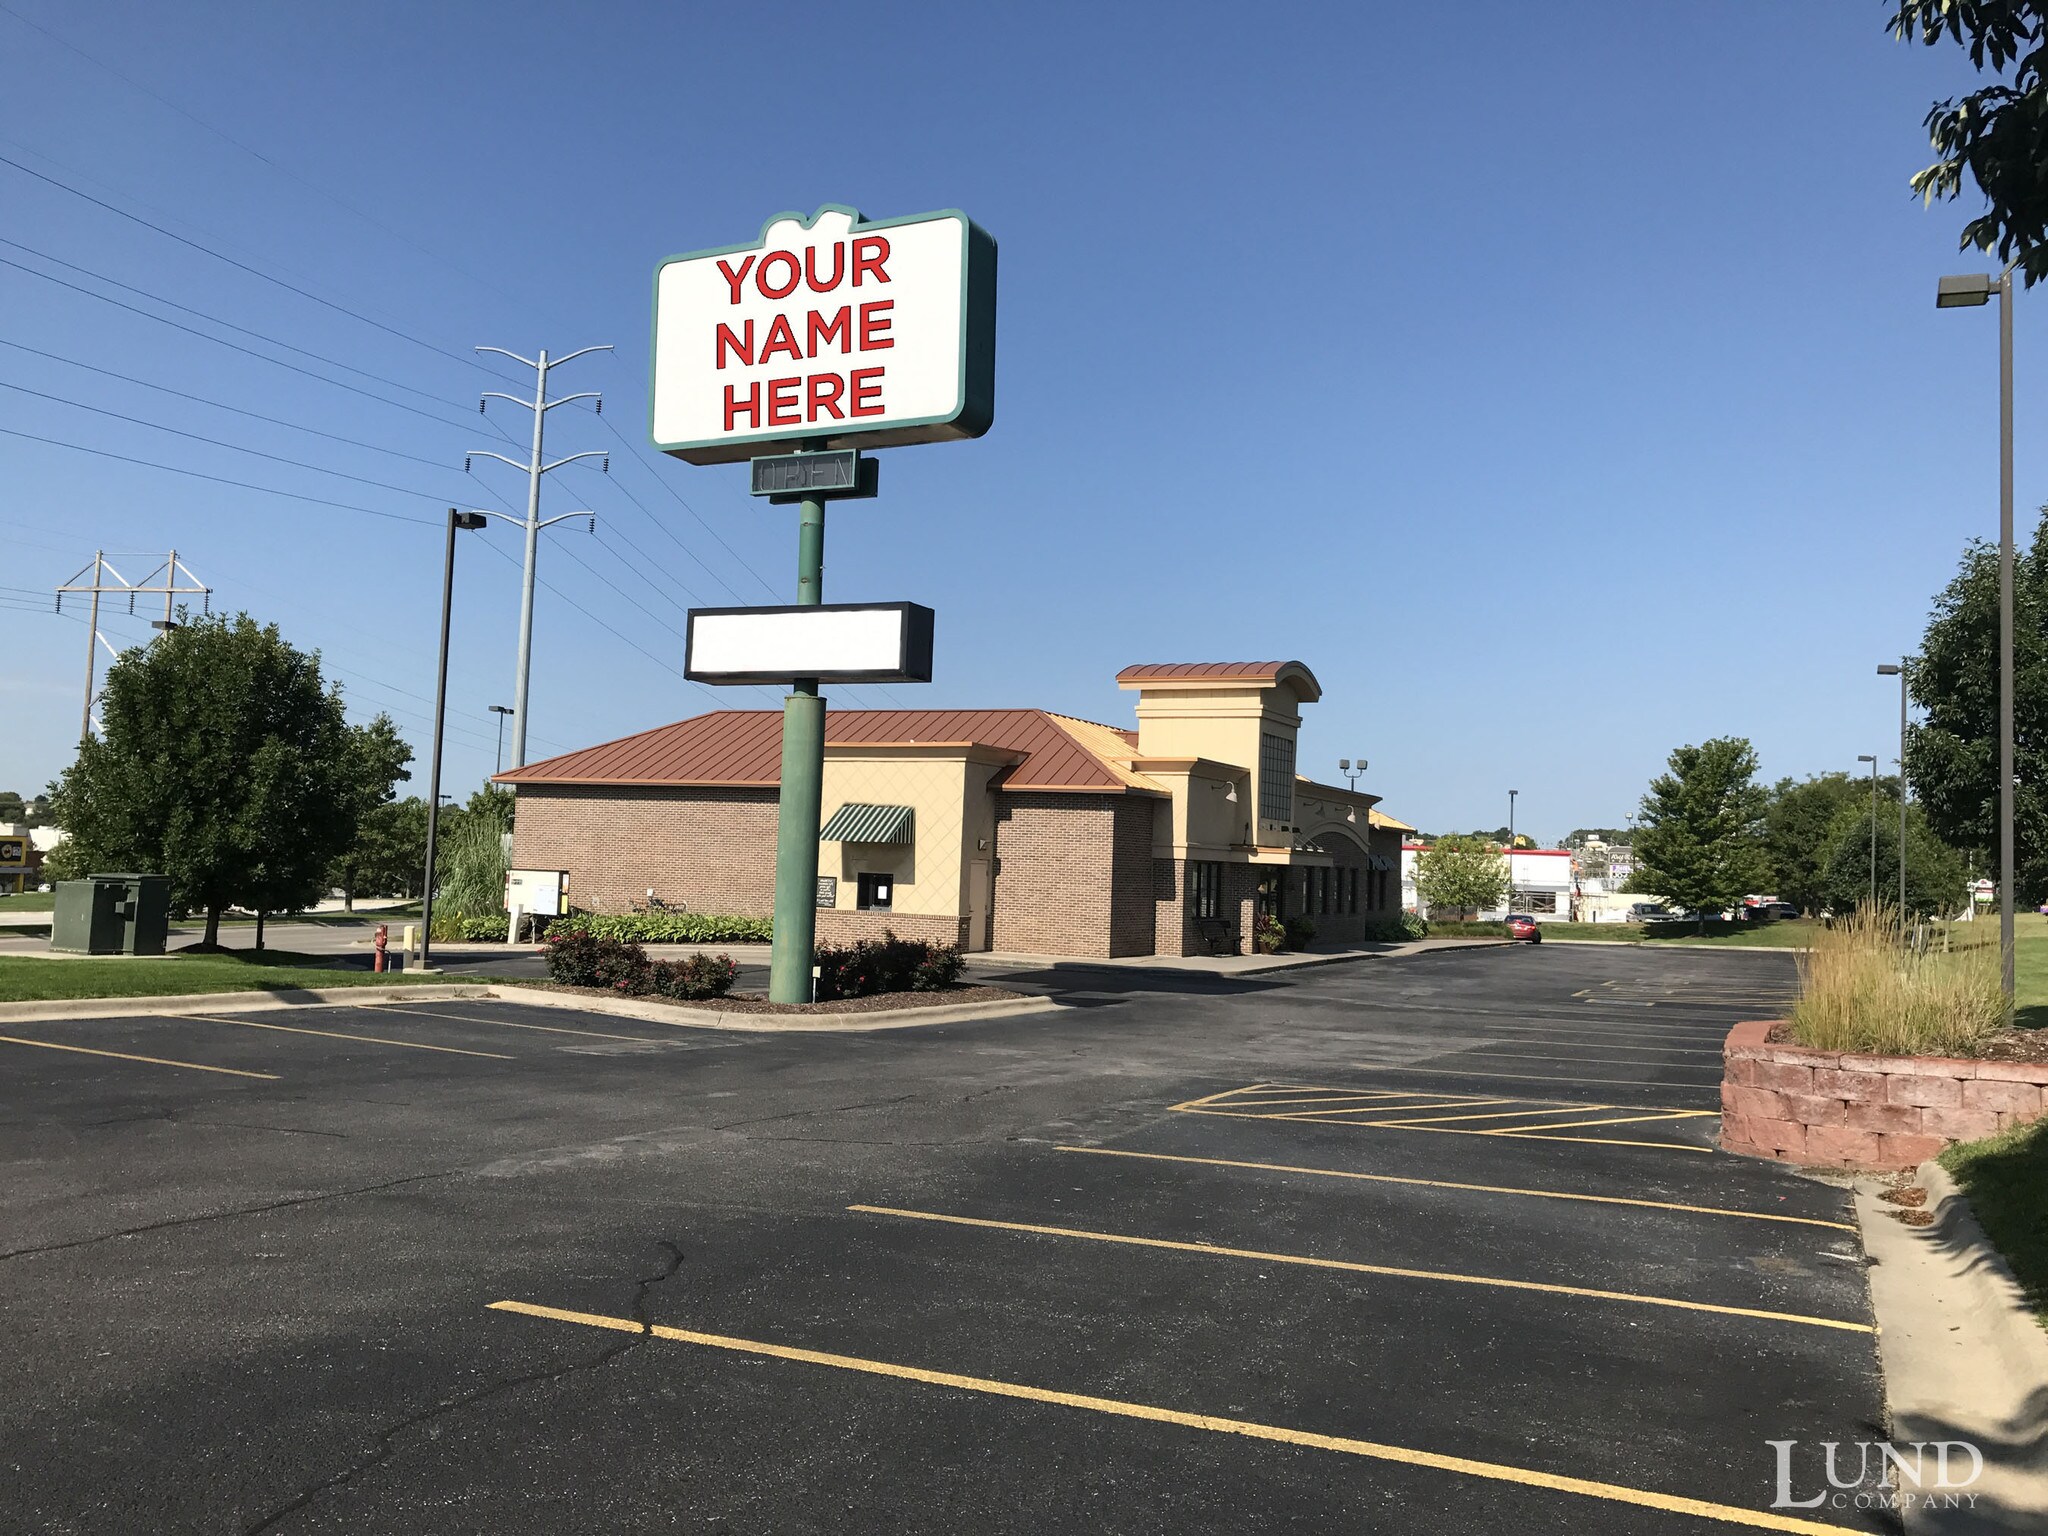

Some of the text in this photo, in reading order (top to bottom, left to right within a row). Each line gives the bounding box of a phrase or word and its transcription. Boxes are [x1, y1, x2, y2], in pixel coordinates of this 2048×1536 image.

[717, 236, 890, 305] YOUR
[716, 299, 895, 369] NAME
[724, 367, 885, 431] HERE
[758, 457, 852, 491] OPEN
